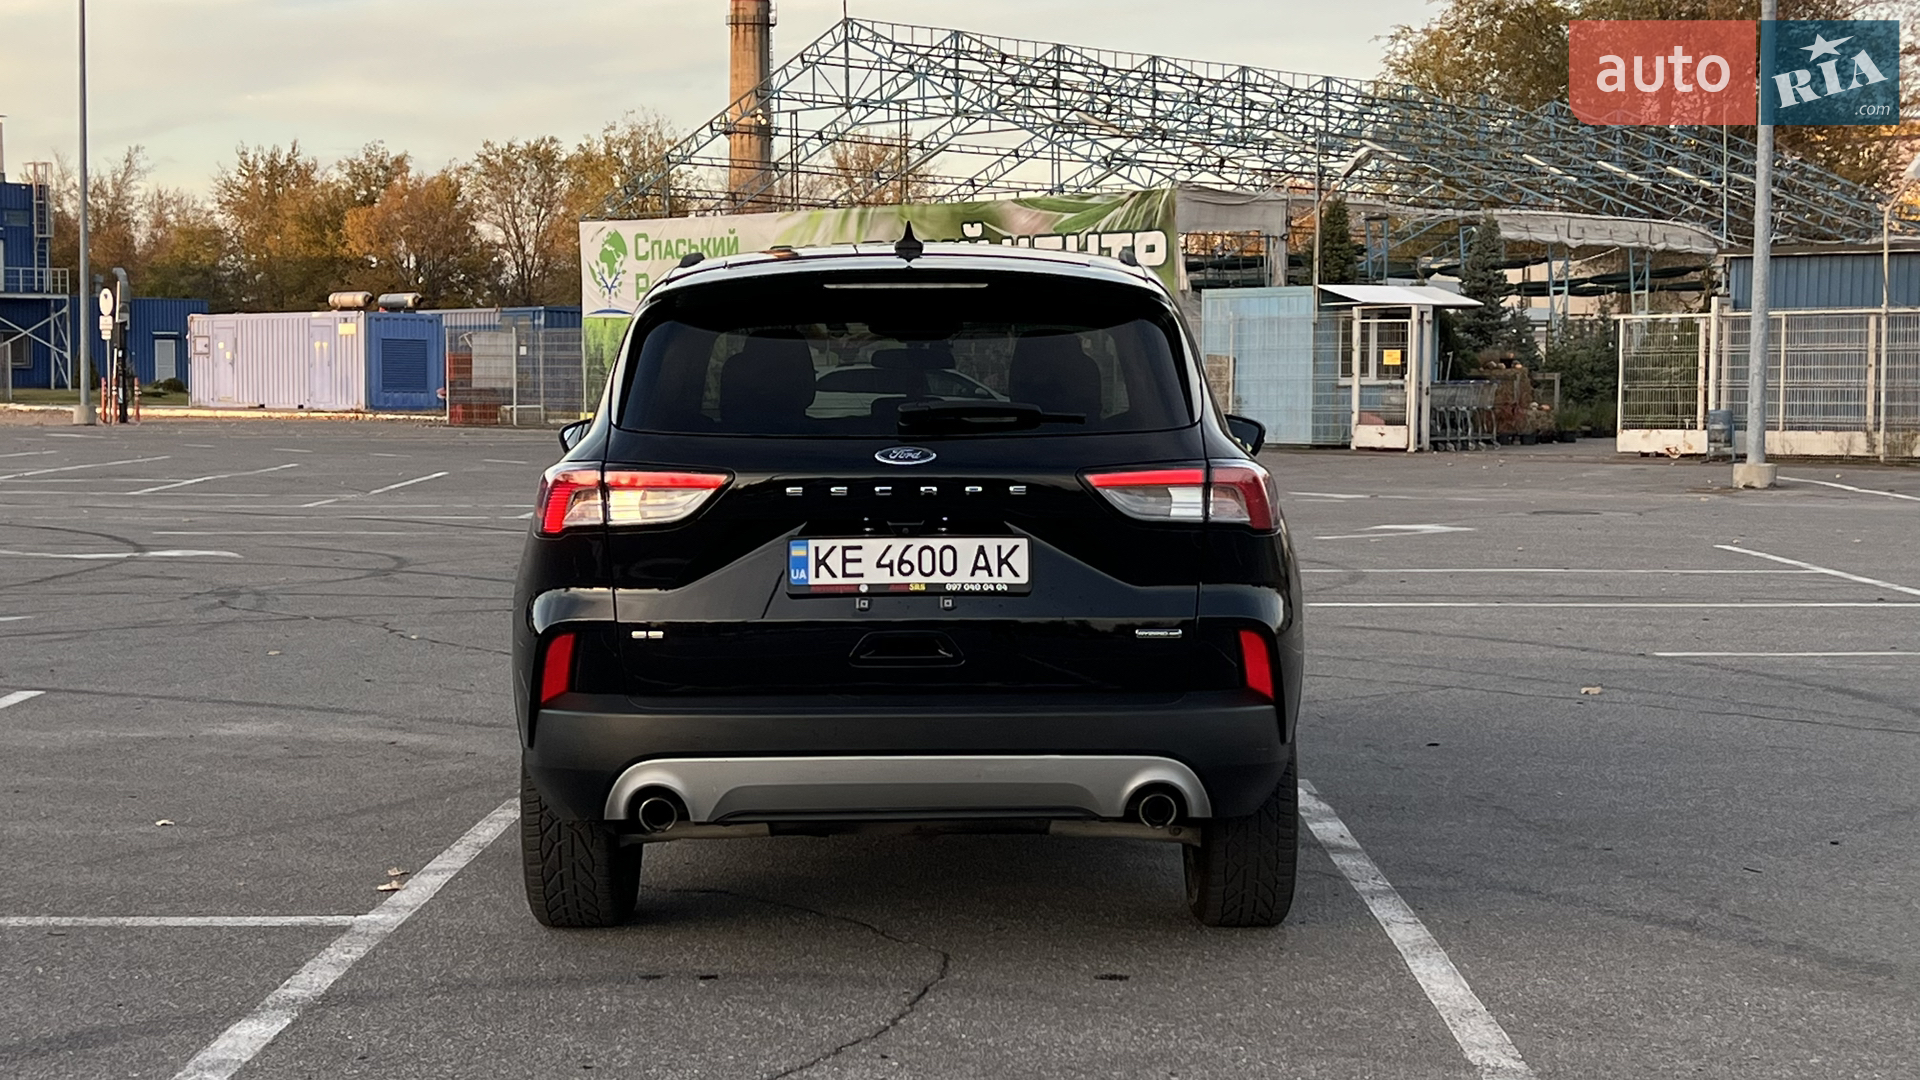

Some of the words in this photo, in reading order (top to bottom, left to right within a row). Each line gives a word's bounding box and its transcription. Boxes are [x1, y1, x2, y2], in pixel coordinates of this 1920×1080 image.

[785, 486, 1027, 496] ESCAPE
[814, 545, 864, 579] KE
[876, 544, 957, 578] 4600
[970, 544, 1020, 578] AK
[791, 569, 807, 580] UA
[945, 583, 962, 591] 097
